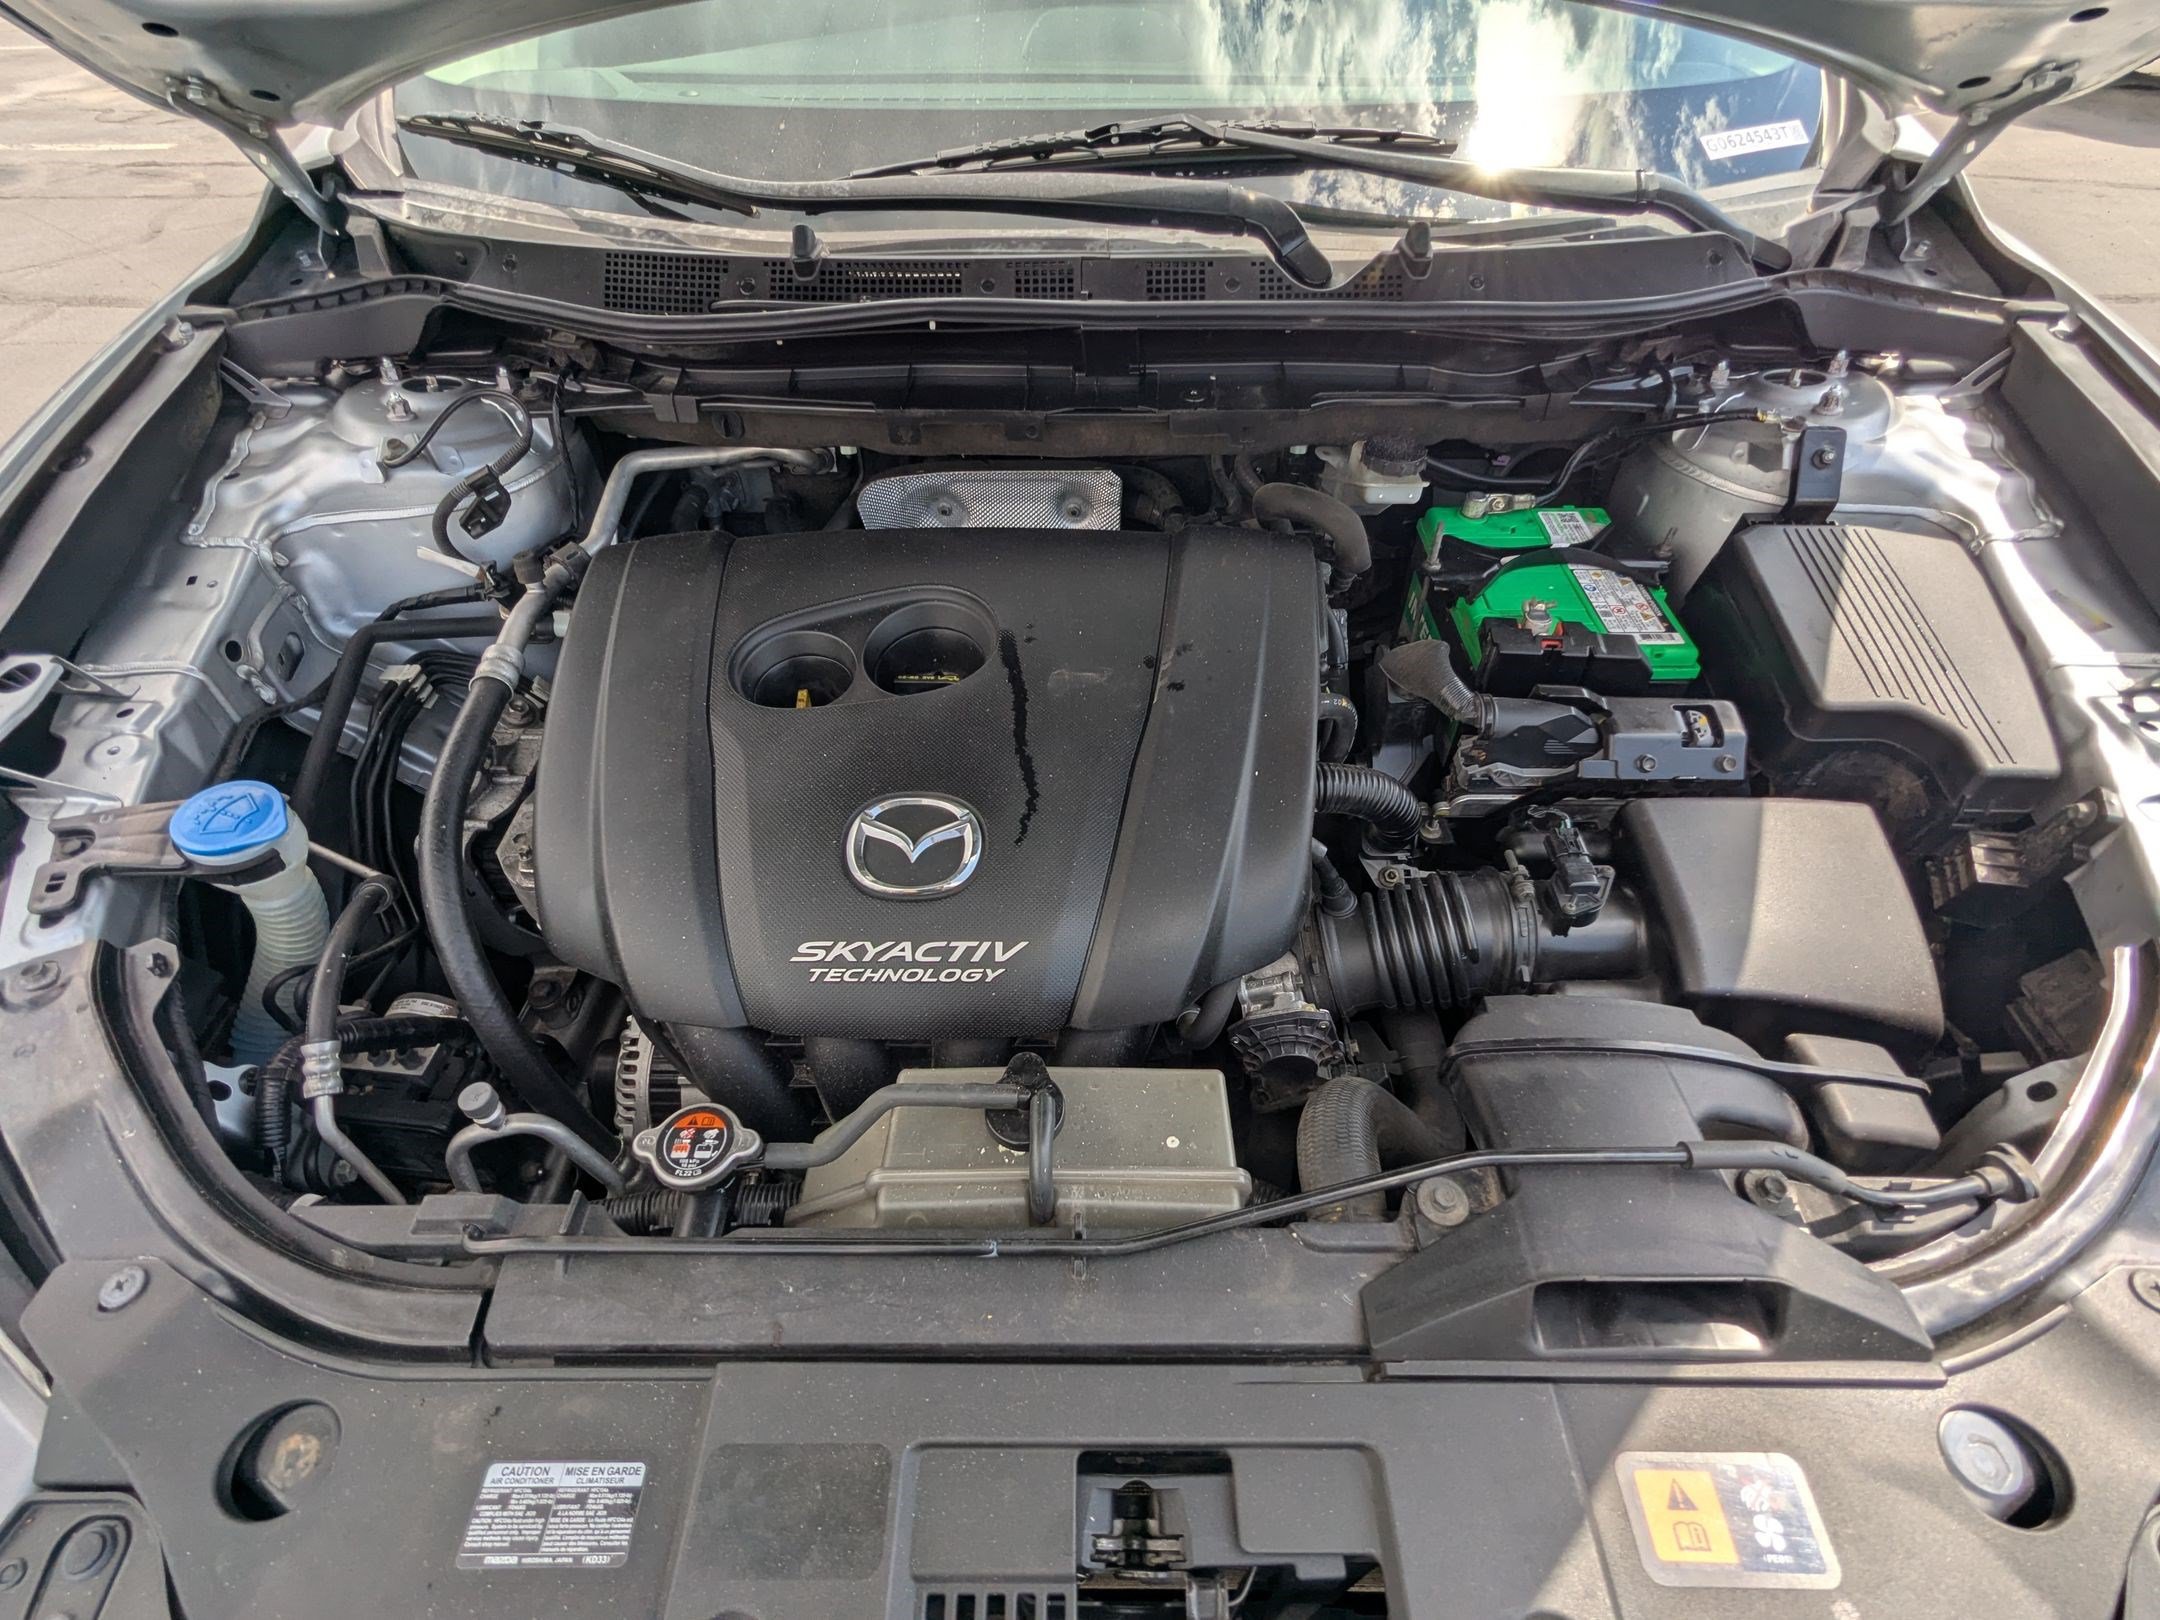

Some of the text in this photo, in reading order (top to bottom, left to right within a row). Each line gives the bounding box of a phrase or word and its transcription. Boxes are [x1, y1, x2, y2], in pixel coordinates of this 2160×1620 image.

[789, 941, 1030, 962] SKYACTIV
[809, 968, 1006, 982] TECHNOLOGY
[501, 1466, 551, 1477] CAUTION
[565, 1466, 642, 1476] MISE EN GARDE
[504, 1477, 555, 1485] CONDITIONER
